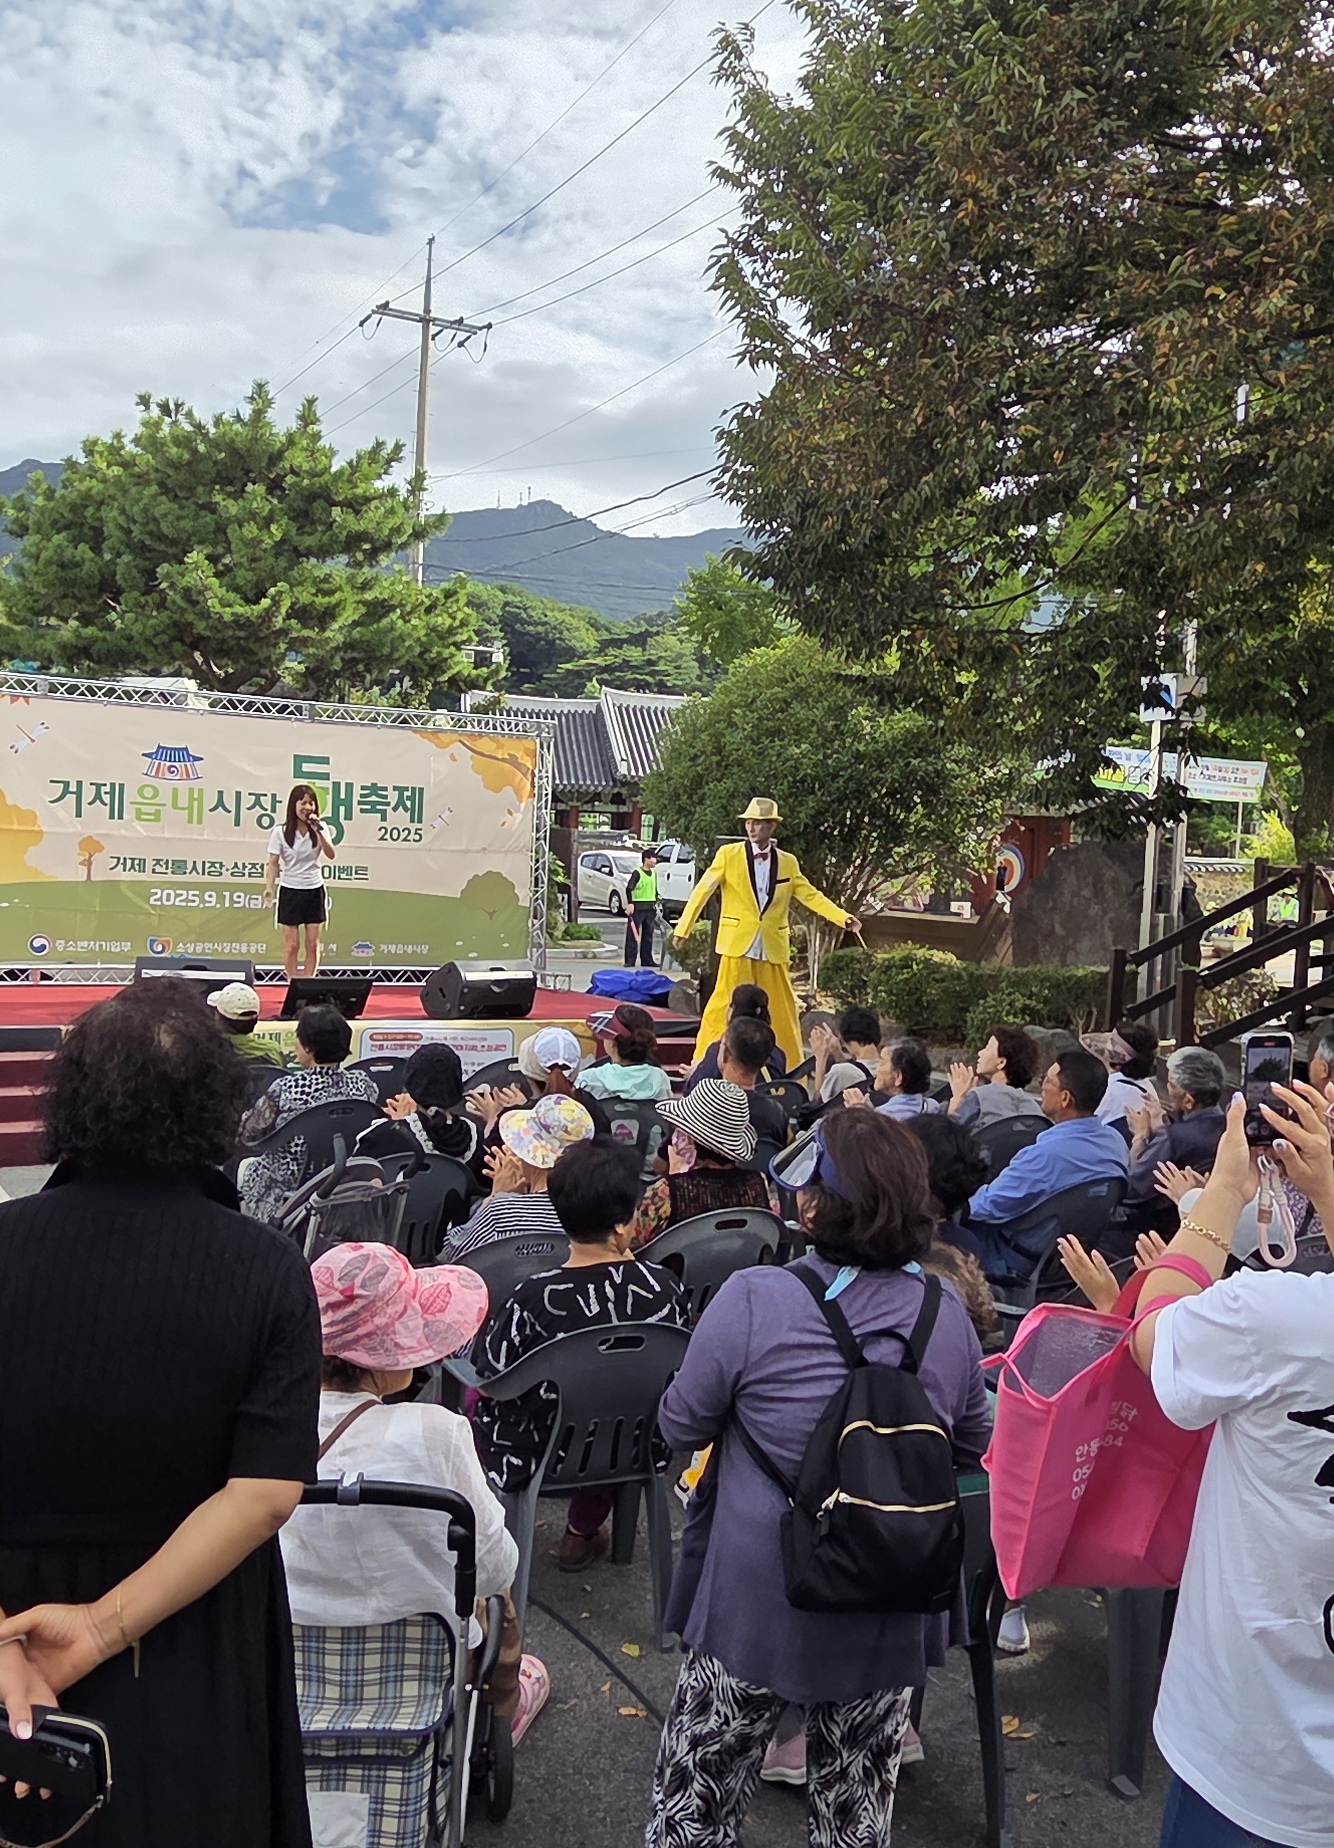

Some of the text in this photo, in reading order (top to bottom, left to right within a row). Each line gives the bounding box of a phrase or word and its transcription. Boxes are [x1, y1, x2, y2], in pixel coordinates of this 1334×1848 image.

[48, 778, 283, 831] 거제읍내시장
[377, 826, 424, 844] 2025
[109, 856, 370, 882] 거제 전통시장·상점 이벤트
